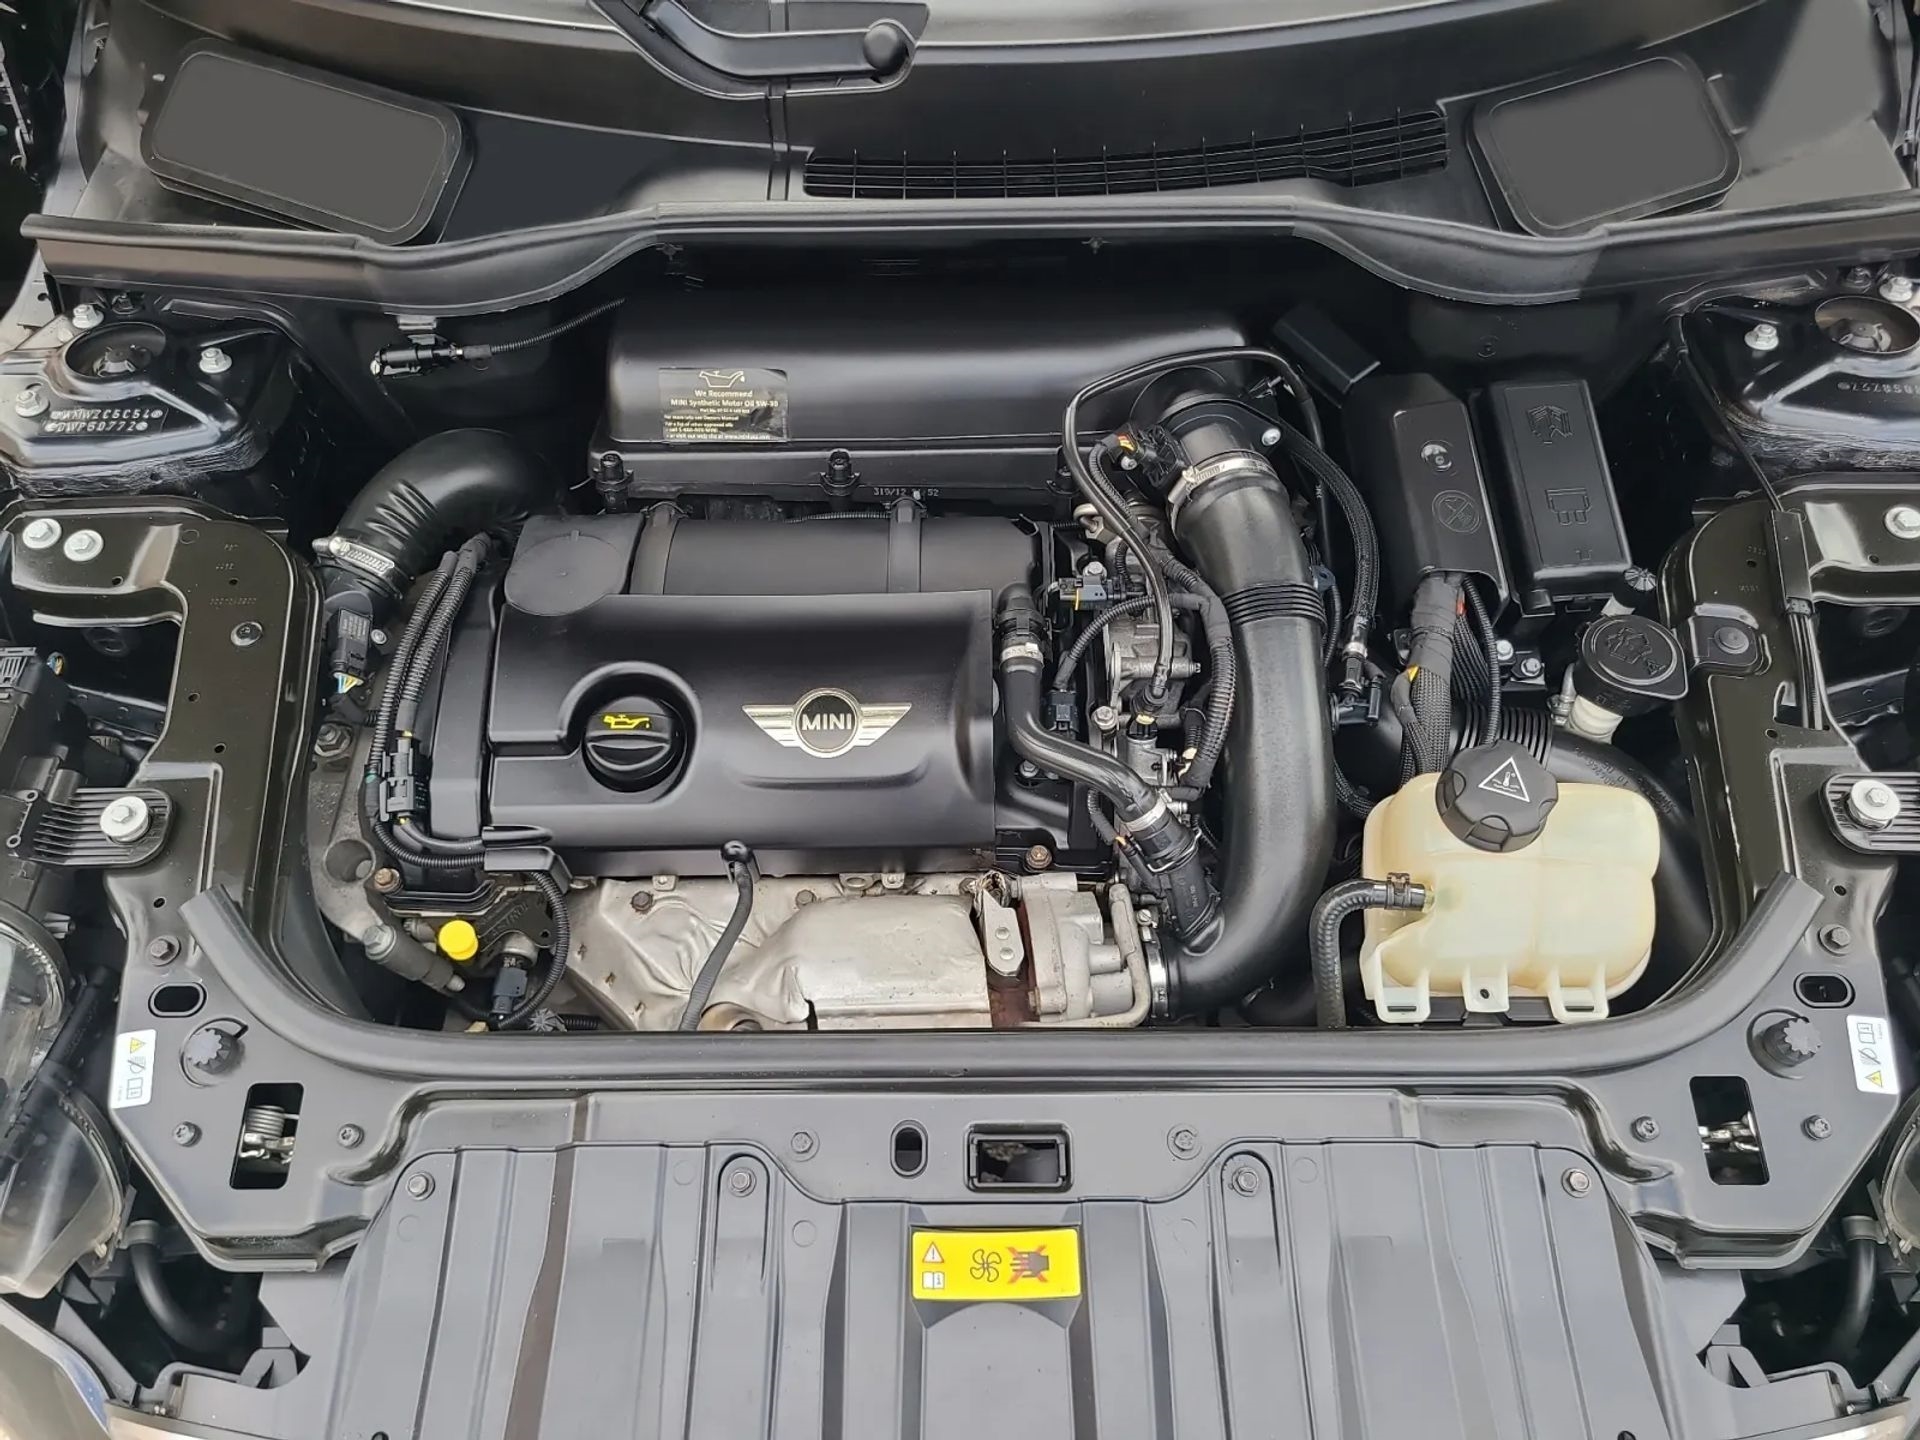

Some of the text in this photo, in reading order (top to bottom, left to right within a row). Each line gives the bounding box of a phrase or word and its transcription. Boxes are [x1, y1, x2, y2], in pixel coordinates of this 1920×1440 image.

[695, 389, 753, 398] We Recommend
[670, 398, 688, 406] MINI
[689, 399, 721, 408] Synthetic
[722, 399, 743, 407] Motor
[801, 713, 852, 731] MINI
